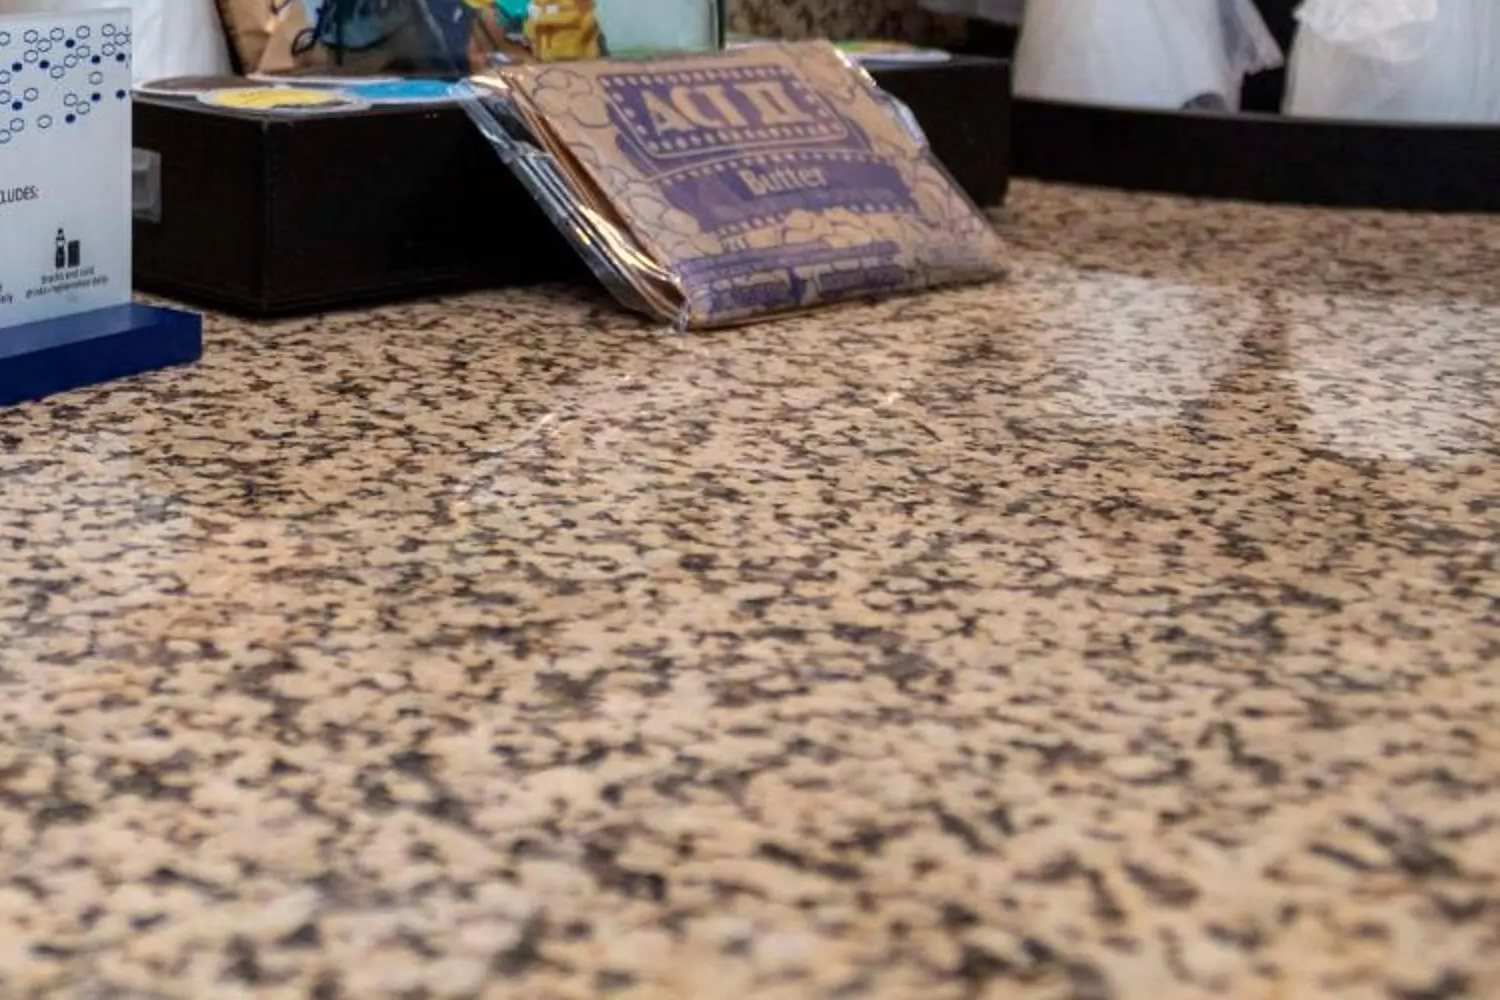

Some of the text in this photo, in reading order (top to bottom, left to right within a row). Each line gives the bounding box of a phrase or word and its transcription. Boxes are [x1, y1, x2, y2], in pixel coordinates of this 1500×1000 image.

[641, 80, 814, 135] ACT II
[737, 167, 827, 196] Butter
